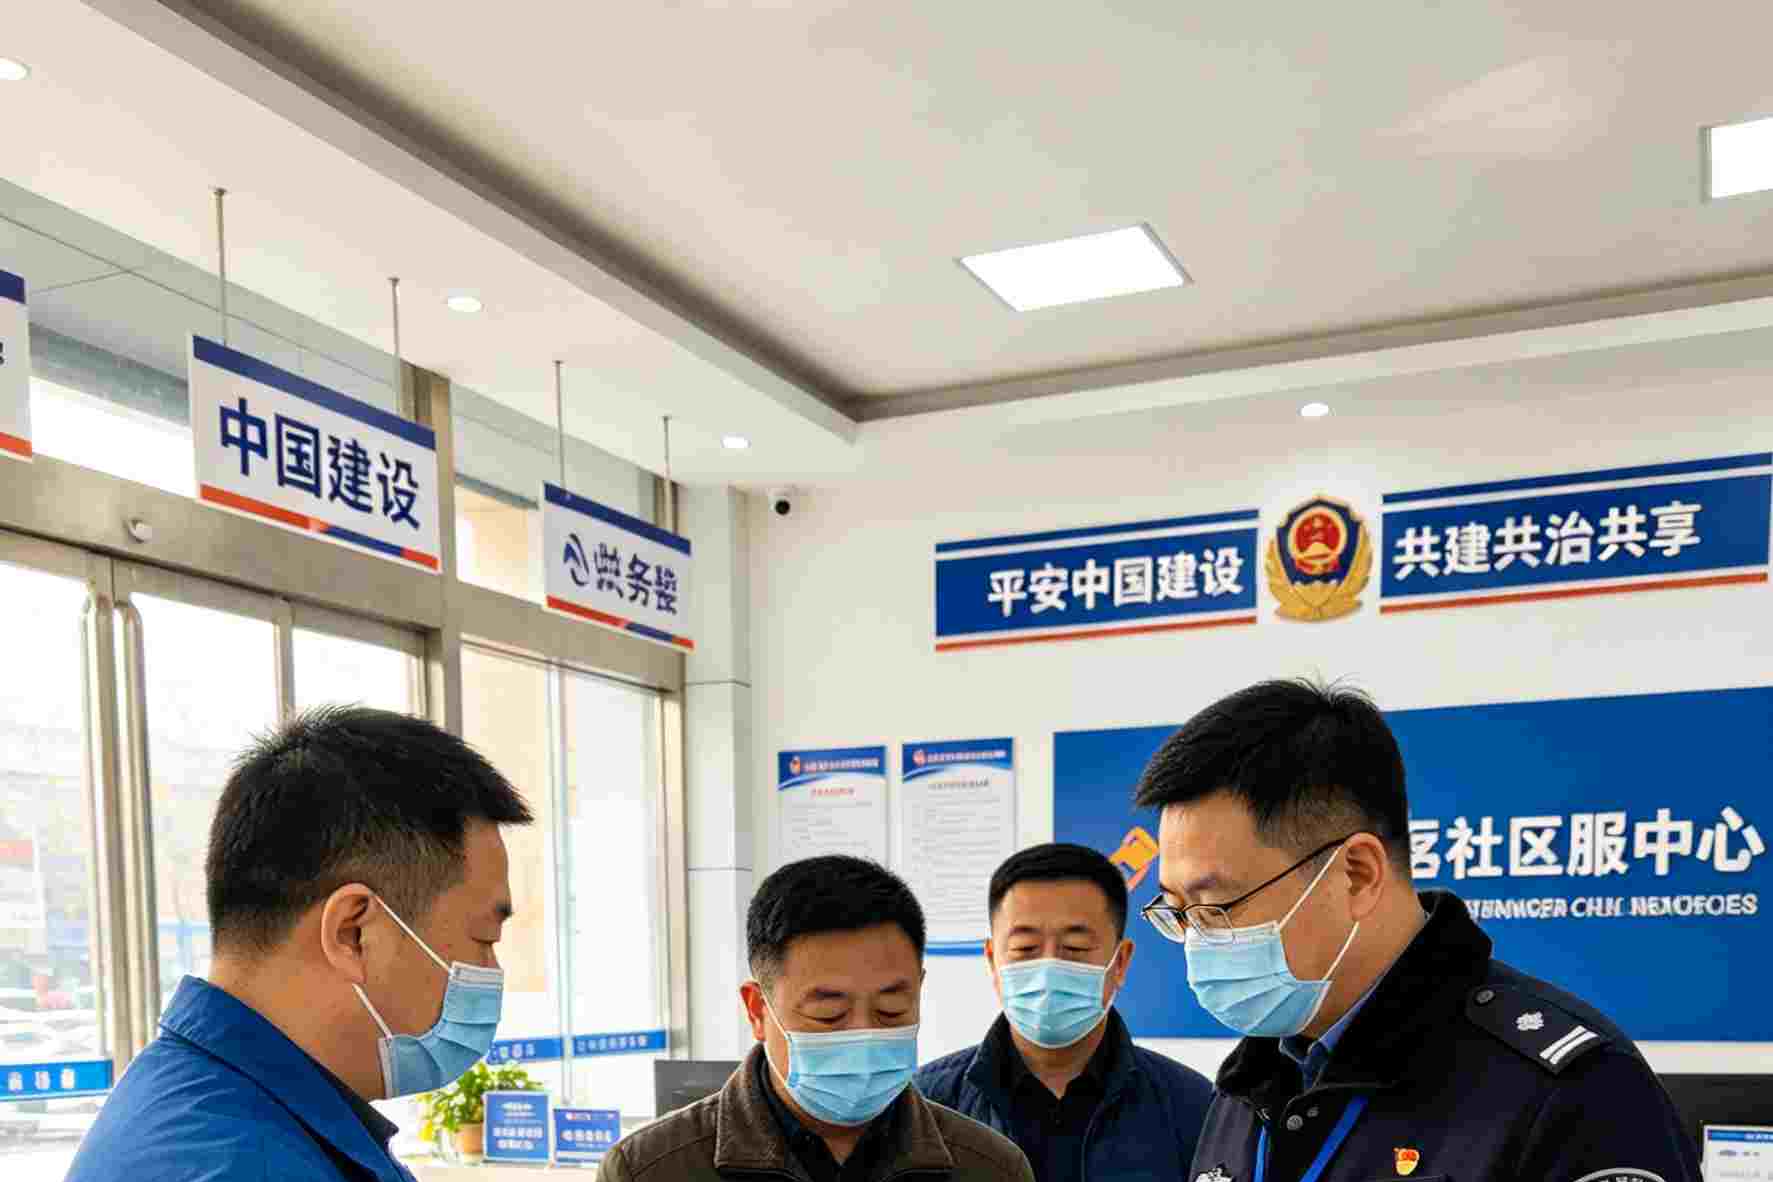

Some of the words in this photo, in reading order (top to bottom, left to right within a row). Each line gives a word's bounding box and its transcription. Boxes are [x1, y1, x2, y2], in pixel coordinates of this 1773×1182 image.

[219, 397, 420, 530] 中国建设
[1393, 500, 1702, 581] 共建共治共享
[987, 547, 1244, 617] 平安中国建设
